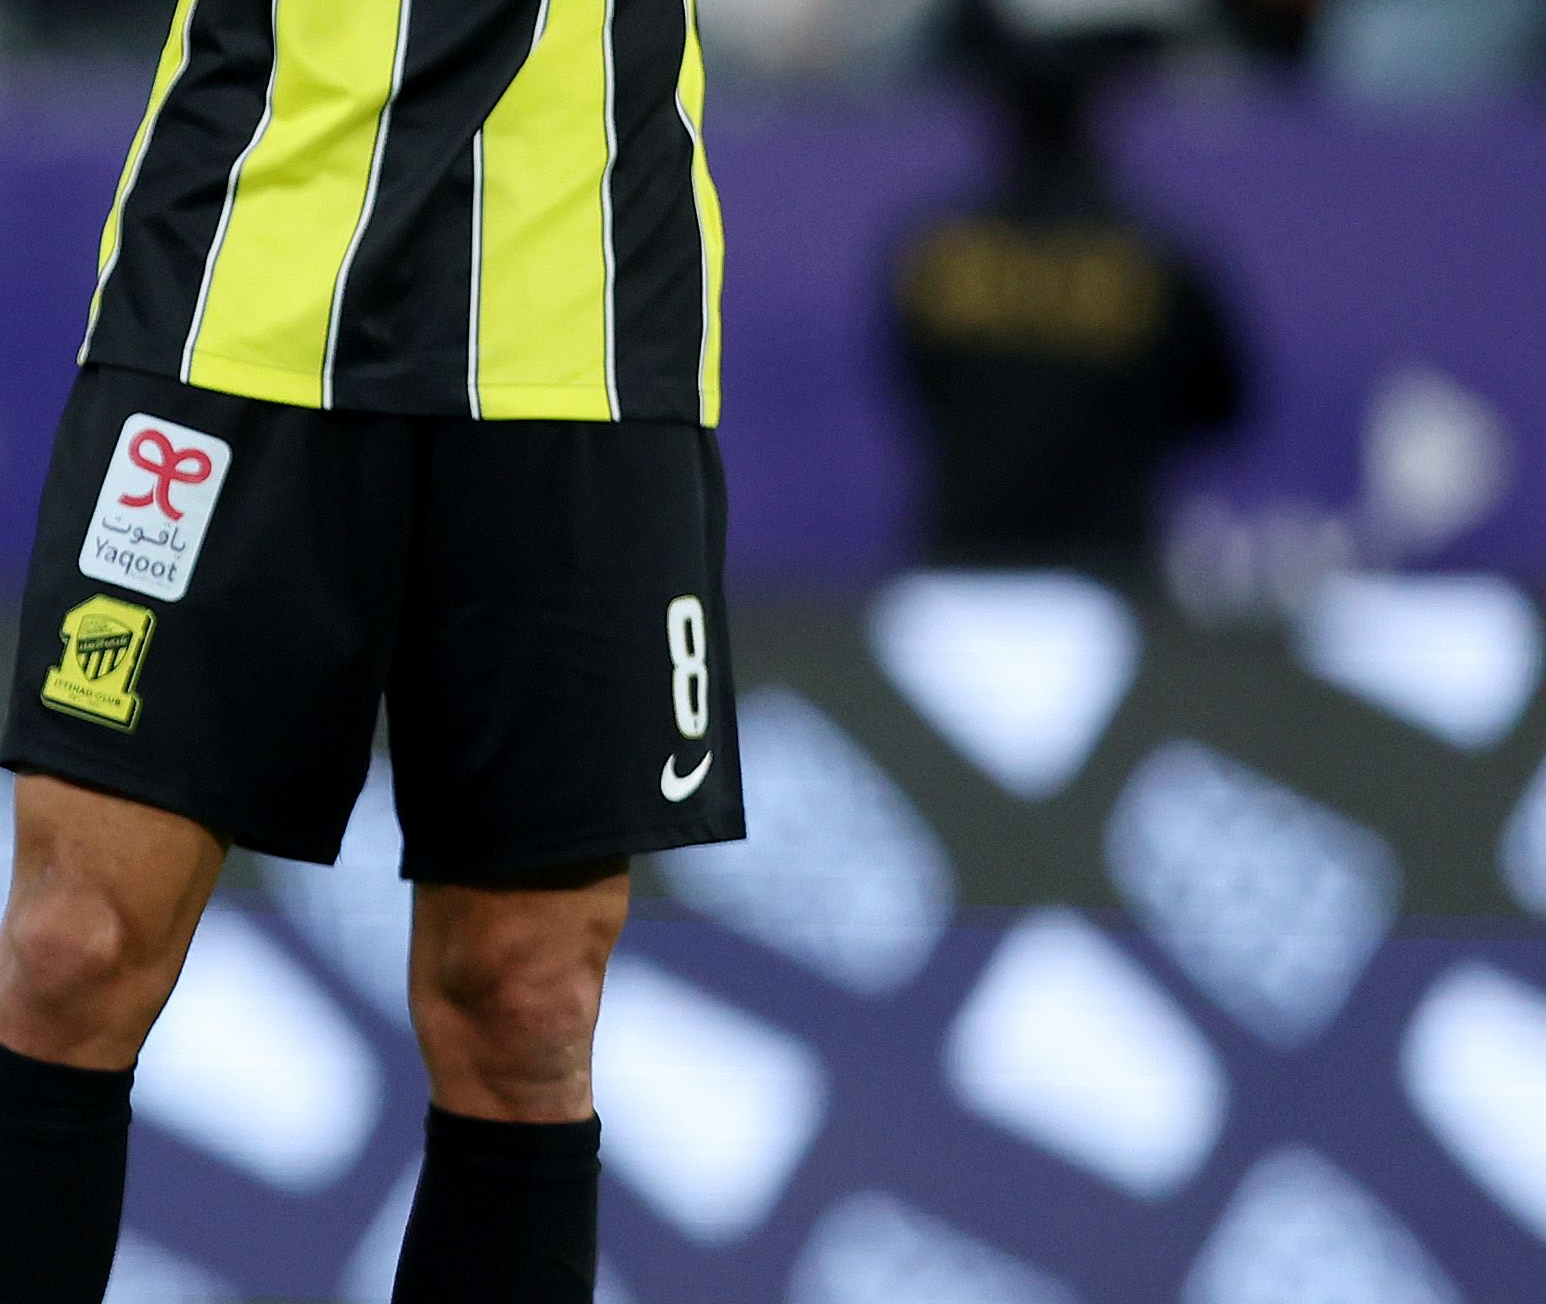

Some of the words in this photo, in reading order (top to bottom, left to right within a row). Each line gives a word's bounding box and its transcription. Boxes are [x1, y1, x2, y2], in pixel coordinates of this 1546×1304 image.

[95, 536, 178, 583] Yaqoot
[101, 516, 186, 560] ياقوت
[666, 594, 709, 740] 8
